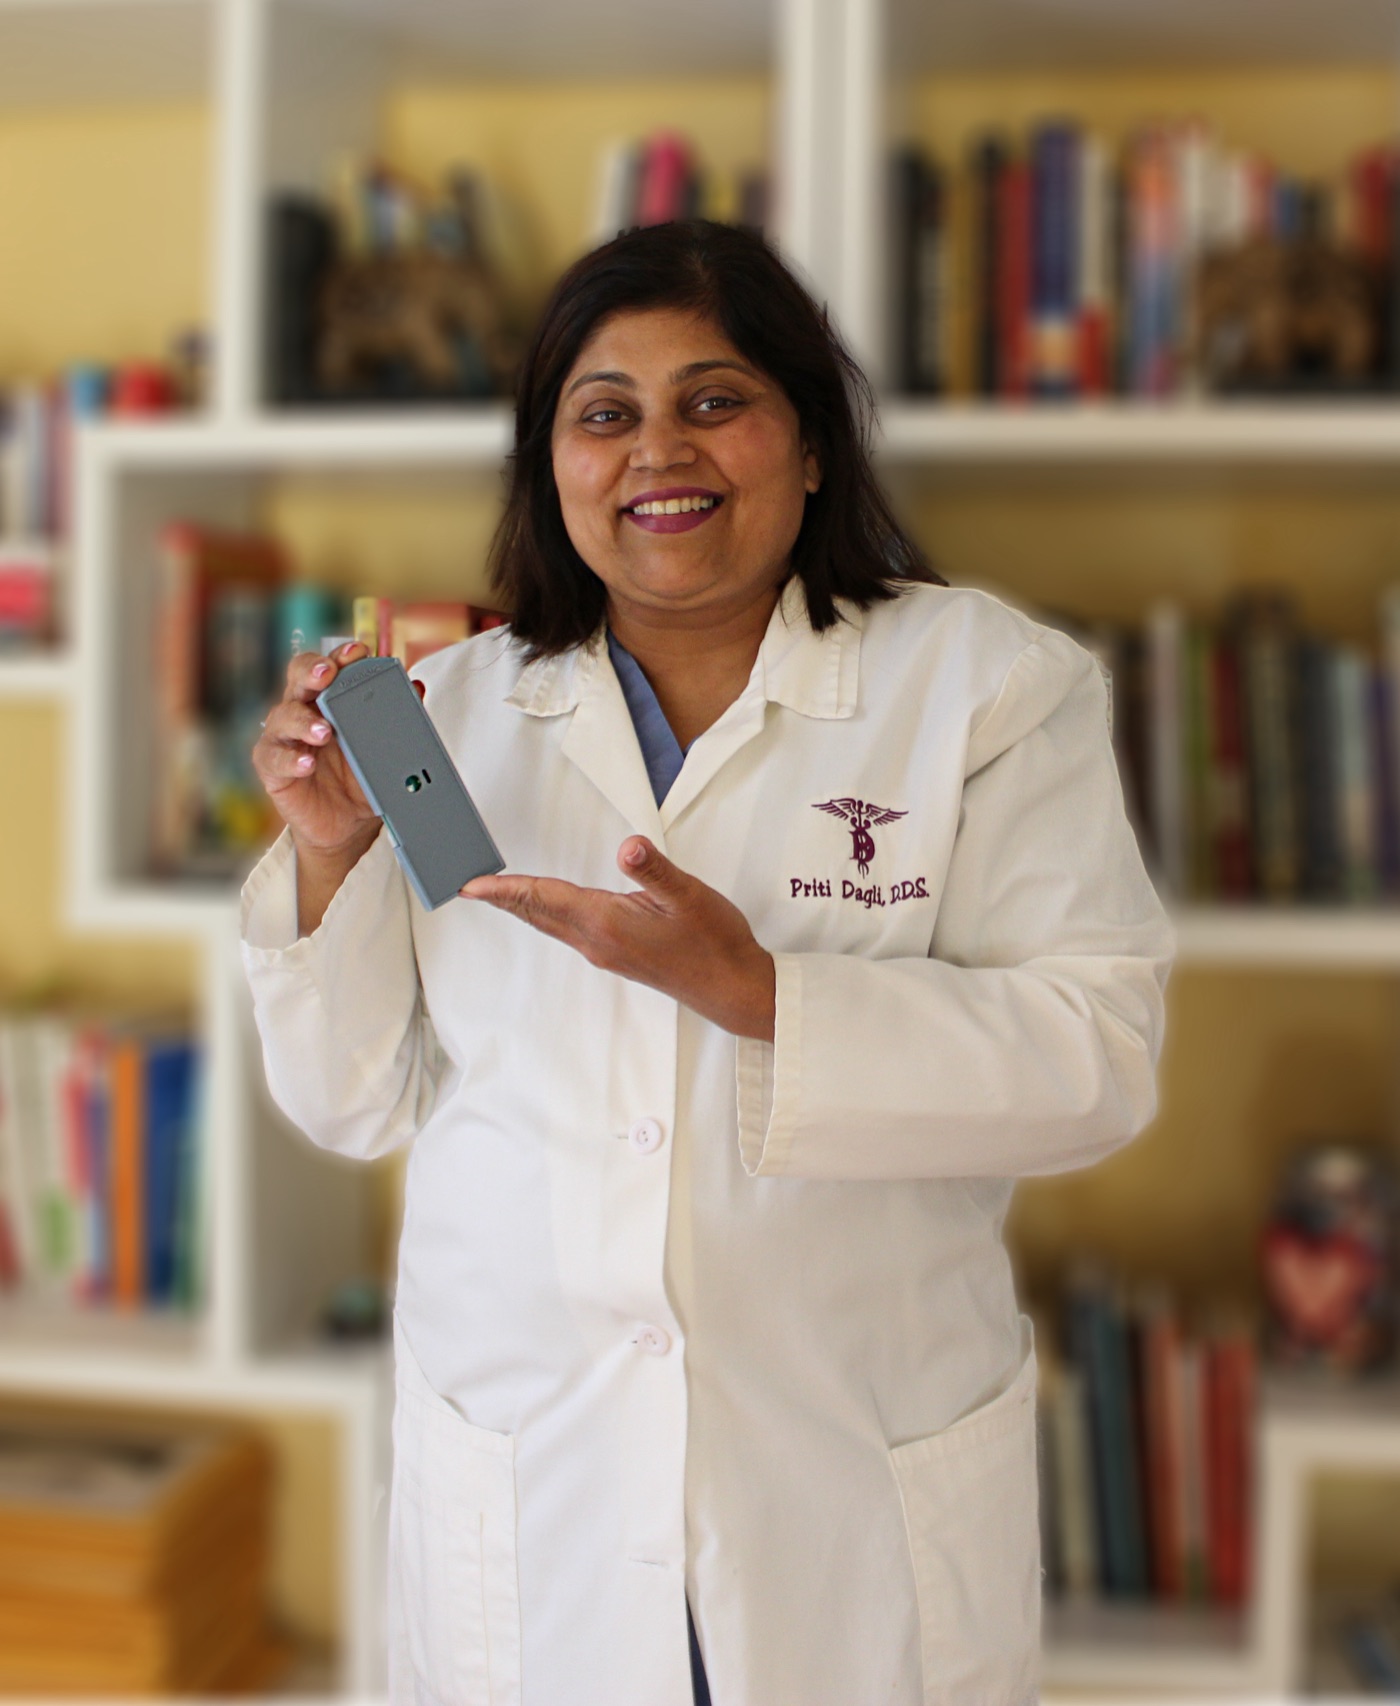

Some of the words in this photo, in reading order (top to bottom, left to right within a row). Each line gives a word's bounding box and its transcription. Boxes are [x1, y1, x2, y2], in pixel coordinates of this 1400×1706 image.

[790, 878, 832, 898] Priti
[842, 880, 886, 909] Dagli,
[890, 877, 930, 904] D.D.S.
